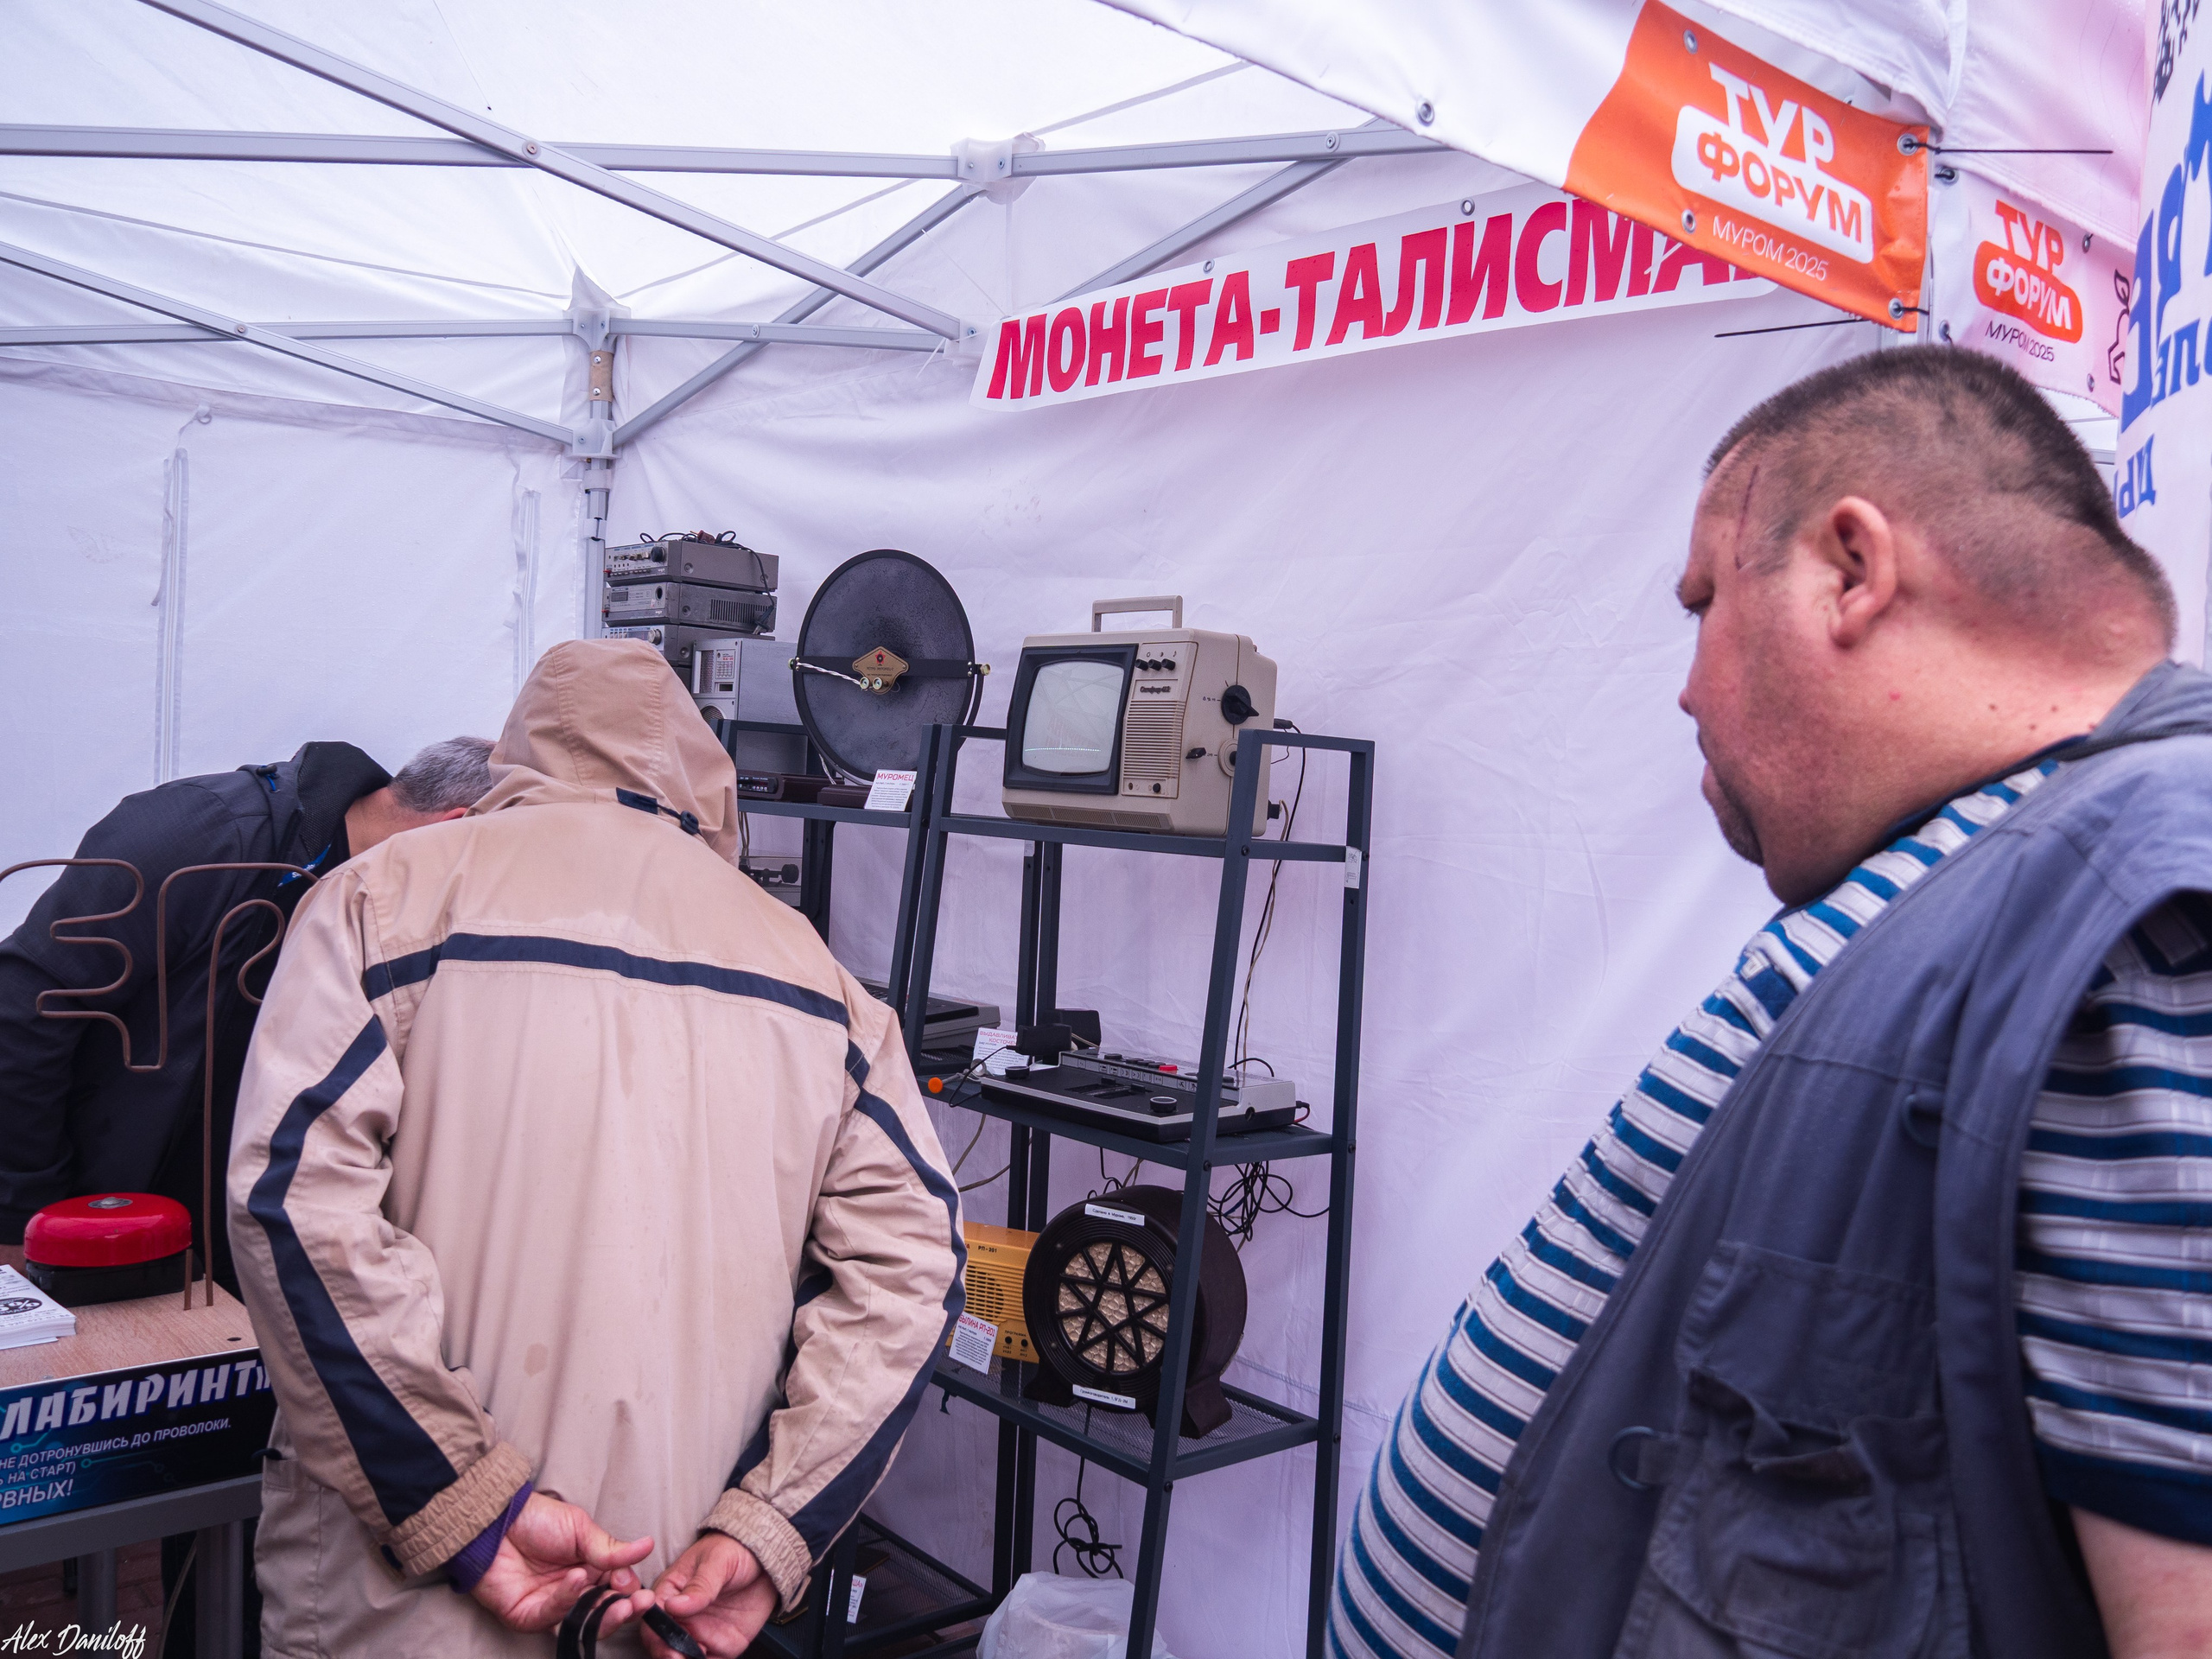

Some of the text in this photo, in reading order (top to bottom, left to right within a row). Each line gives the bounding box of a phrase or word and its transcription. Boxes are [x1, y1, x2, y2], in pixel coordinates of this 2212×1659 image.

[1709, 61, 1834, 172] ТУР
[1697, 131, 1861, 244] ФОРУМ
[1713, 216, 1828, 281] МУРОМ 2025
[1995, 200, 2064, 275] ТУР
[986, 197, 1760, 400] МОНЕТА-ТАЛИСМА
[1986, 257, 2072, 330] ФОРУМ
[2030, 339, 2055, 362] 2025
[877, 772, 915, 782] МУРОМЕЦ
[979, 1031, 1017, 1039] ВЫДАВЛИВА
[8, 1470, 26, 1484] НА
[30, 1461, 76, 1479] СТАРТ)
[18, 1437, 129, 1469] ДОТРОНУВШИСЬ
[130, 1432, 151, 1448] ДО
[153, 1418, 231, 1442] ПРОВОЛОКИ.
[0, 1478, 73, 1509] ВНЫХ!
